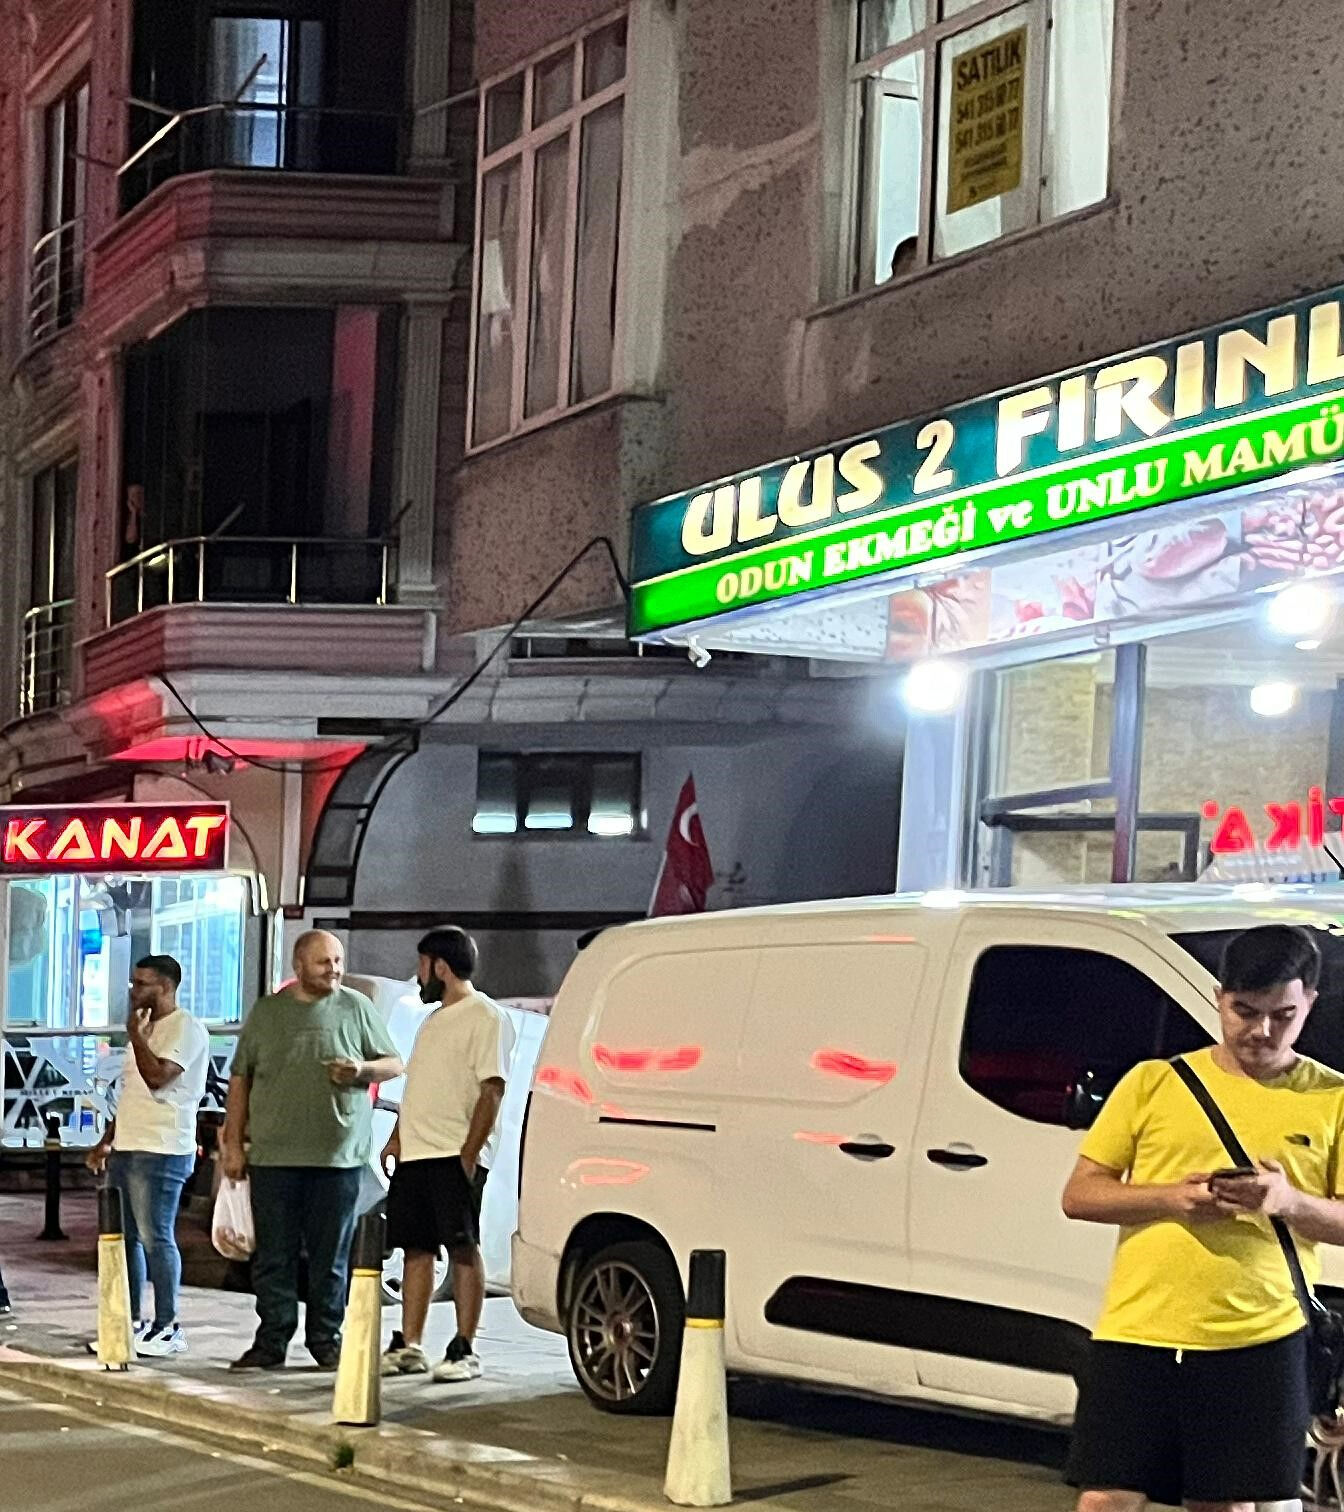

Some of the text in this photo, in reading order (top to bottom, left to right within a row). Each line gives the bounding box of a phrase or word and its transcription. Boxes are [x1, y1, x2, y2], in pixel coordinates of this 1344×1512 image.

[957, 35, 1022, 91] SATILIK
[681, 440, 884, 556] ULUS
[913, 419, 955, 495] 2
[716, 551, 814, 603] ODUN
[823, 500, 977, 577] EKMEĞİ
[987, 500, 1034, 533] ve
[1046, 458, 1169, 520] UNLU
[4, 815, 226, 861] KANAT
